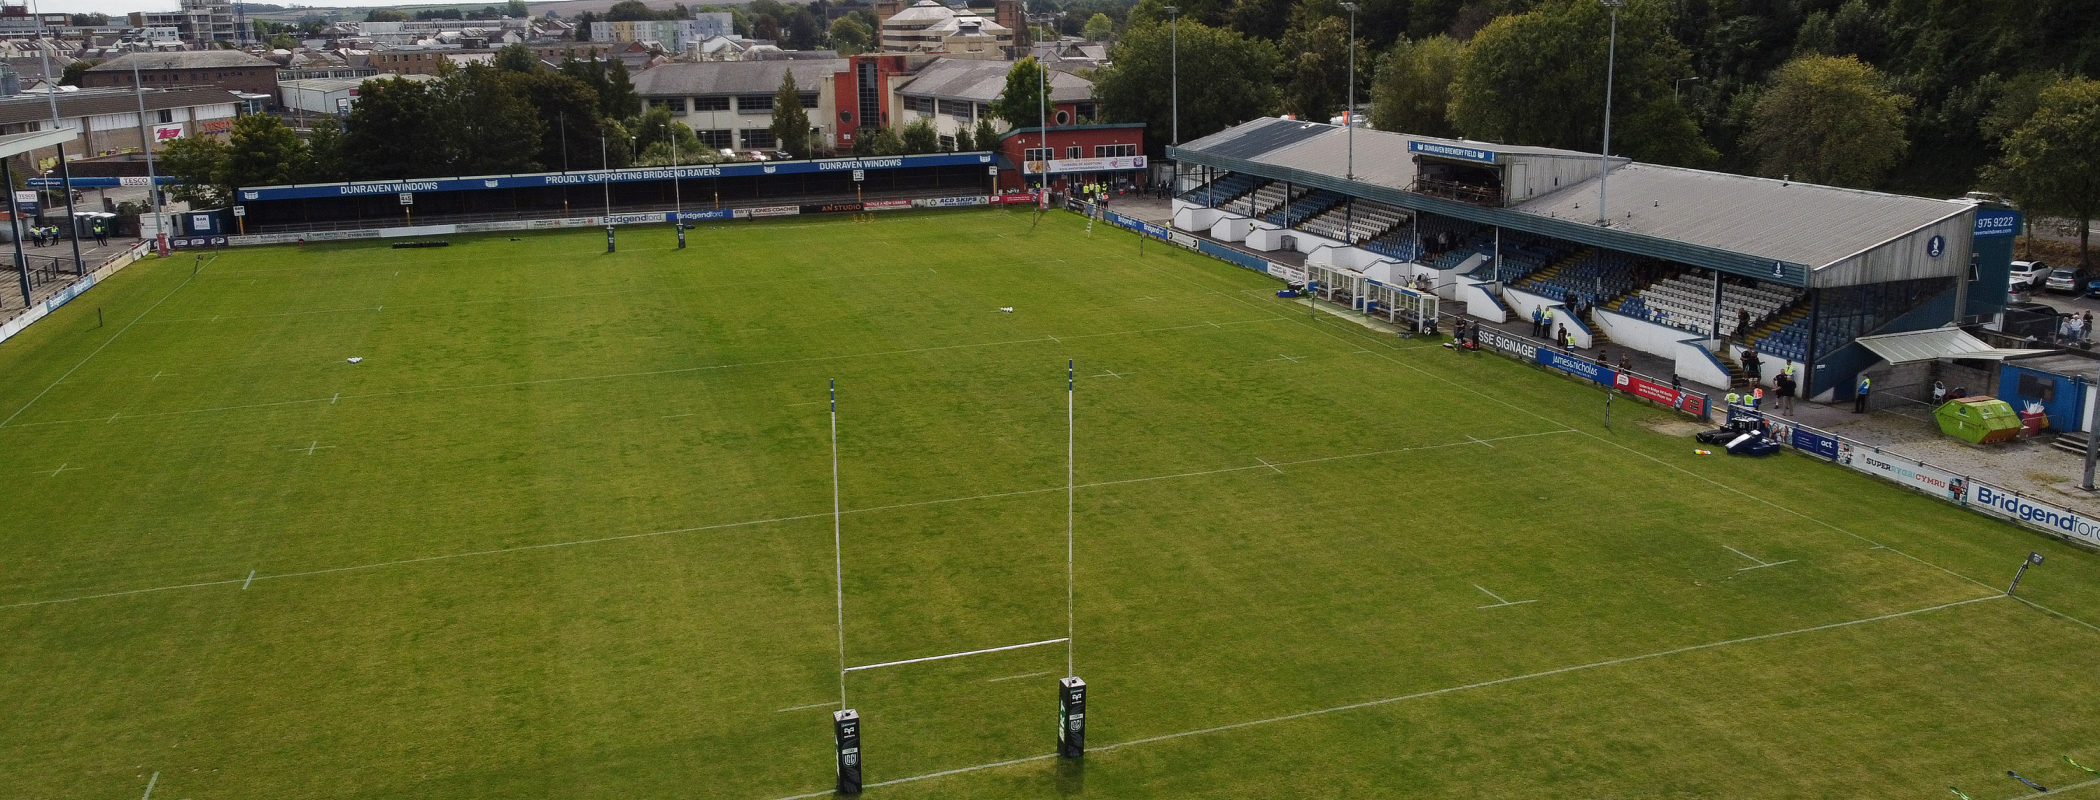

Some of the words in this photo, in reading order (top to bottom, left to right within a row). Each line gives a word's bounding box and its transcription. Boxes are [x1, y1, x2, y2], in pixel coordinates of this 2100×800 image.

[203, 120, 232, 130] TESCO
[1424, 144, 1444, 153] DUNRAVEN
[1444, 147, 1463, 156] BREWERY
[1464, 150, 1477, 158] FIELD
[819, 161, 863, 171] DUNRAVEN
[864, 158, 902, 168] WINDOWS
[545, 173, 586, 185] PROUDLY
[587, 171, 643, 182] SUPPORTING
[643, 170, 686, 179] BRIDGEND
[687, 168, 721, 178] RAVENS
[340, 184, 391, 194] DUNRAVEN
[393, 182, 438, 191] WINDOWS
[604, 214, 662, 224] Bridgendford
[677, 211, 724, 220] Bridgendford
[1978, 218, 1992, 228] 975
[1994, 216, 2014, 227] 9222
[1479, 330, 1494, 345] SSE
[1496, 336, 1533, 358] SIGNAGE
[1820, 440, 1832, 448] act
[1978, 486, 2100, 541] Bridgendfor
